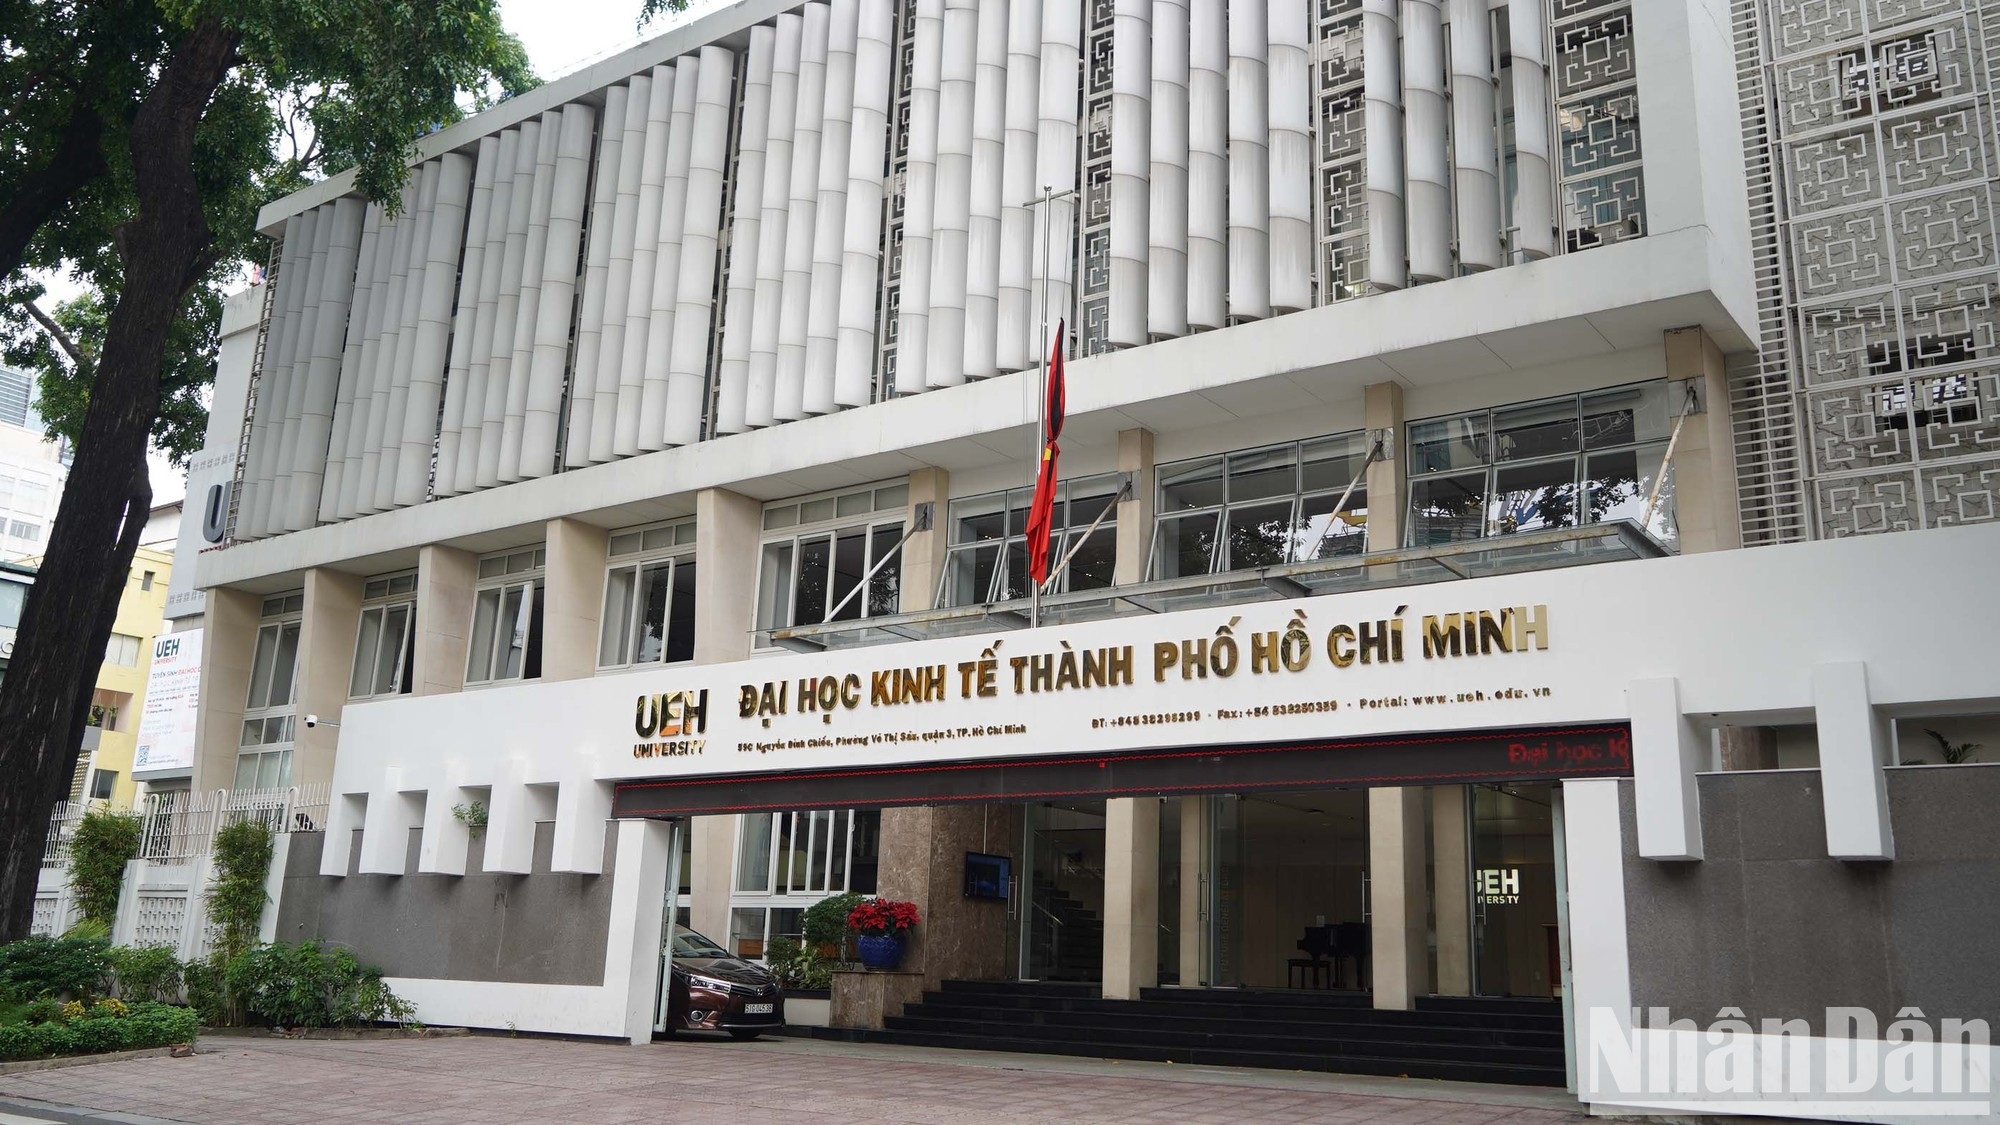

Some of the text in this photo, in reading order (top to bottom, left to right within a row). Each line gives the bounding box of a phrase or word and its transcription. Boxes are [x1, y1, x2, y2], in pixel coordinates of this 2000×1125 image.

[156, 638, 180, 658] UEH
[739, 605, 1548, 728] ĐẠI HỌC KINH TẾ THÀNH PHỐ HỒ CHÍ MINH
[1359, 695, 1408, 709] Portal:
[635, 688, 709, 738] UEH
[884, 732, 897, 745] Thị
[987, 725, 1003, 736] Chí
[1005, 724, 1027, 735] Minh
[633, 739, 706, 758] UNIVERSITY
